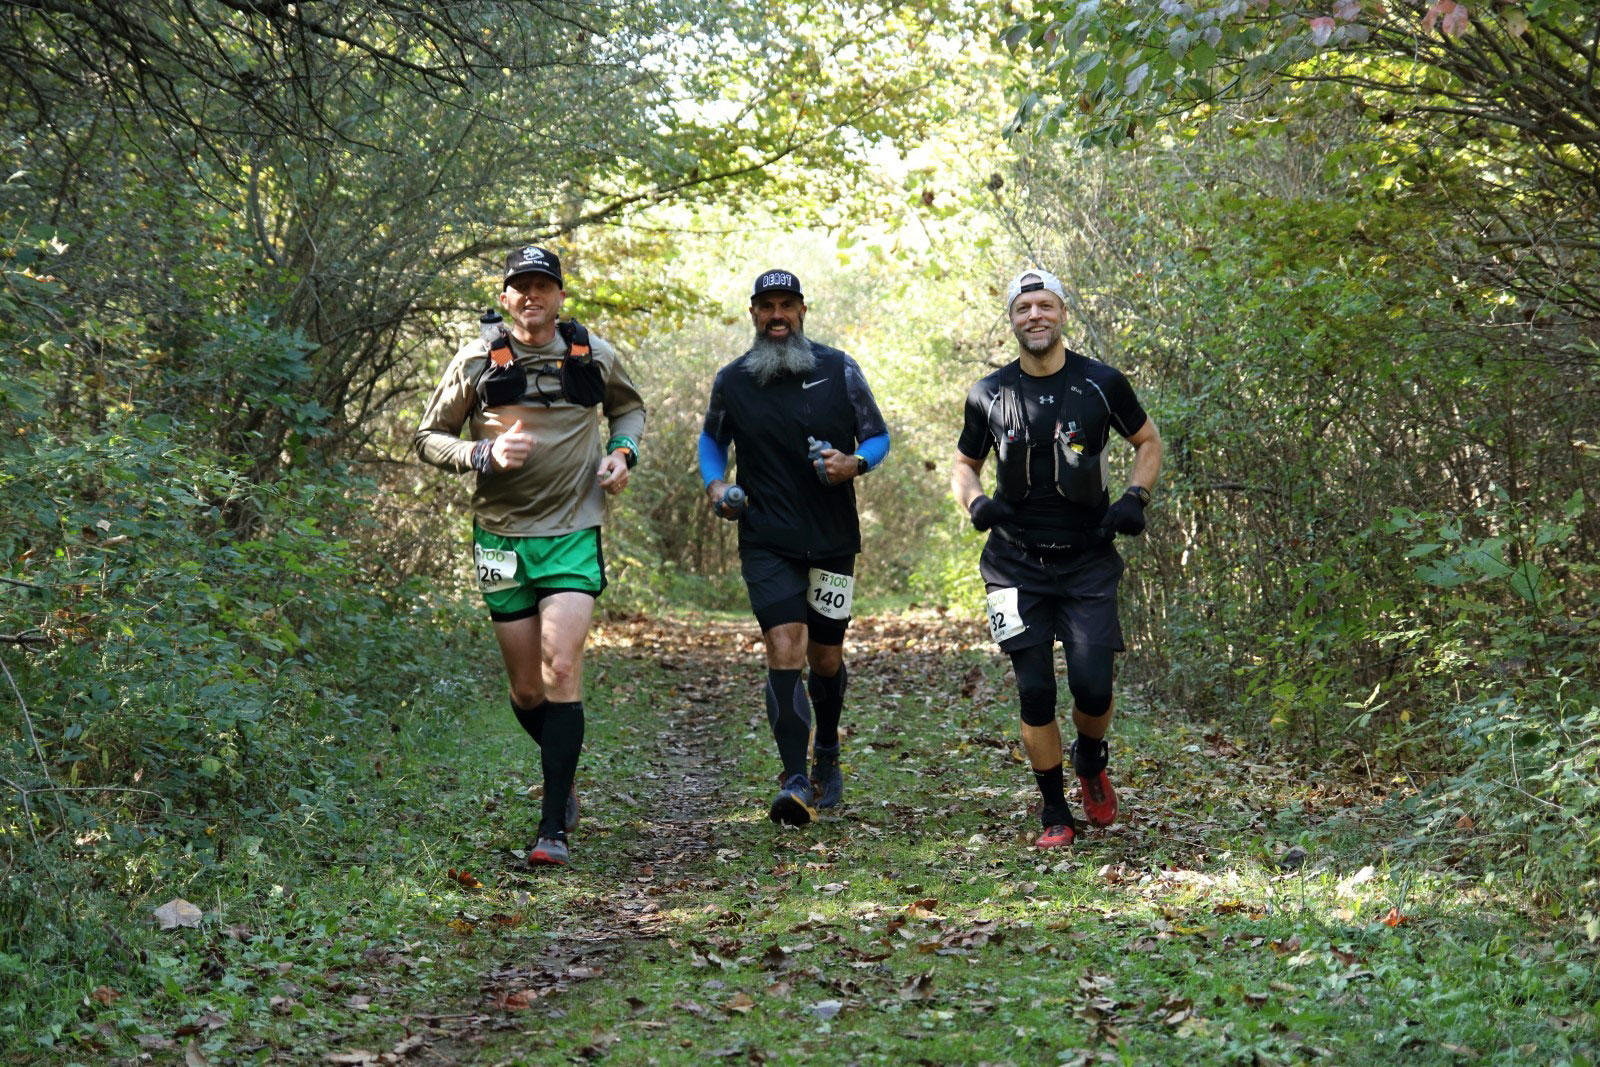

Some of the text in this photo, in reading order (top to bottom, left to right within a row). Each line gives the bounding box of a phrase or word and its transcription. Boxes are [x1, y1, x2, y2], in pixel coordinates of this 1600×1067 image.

[762, 272, 792, 288] BEAST
[829, 575, 848, 589] 100
[813, 587, 846, 609] 140
[820, 605, 832, 614] JOE
